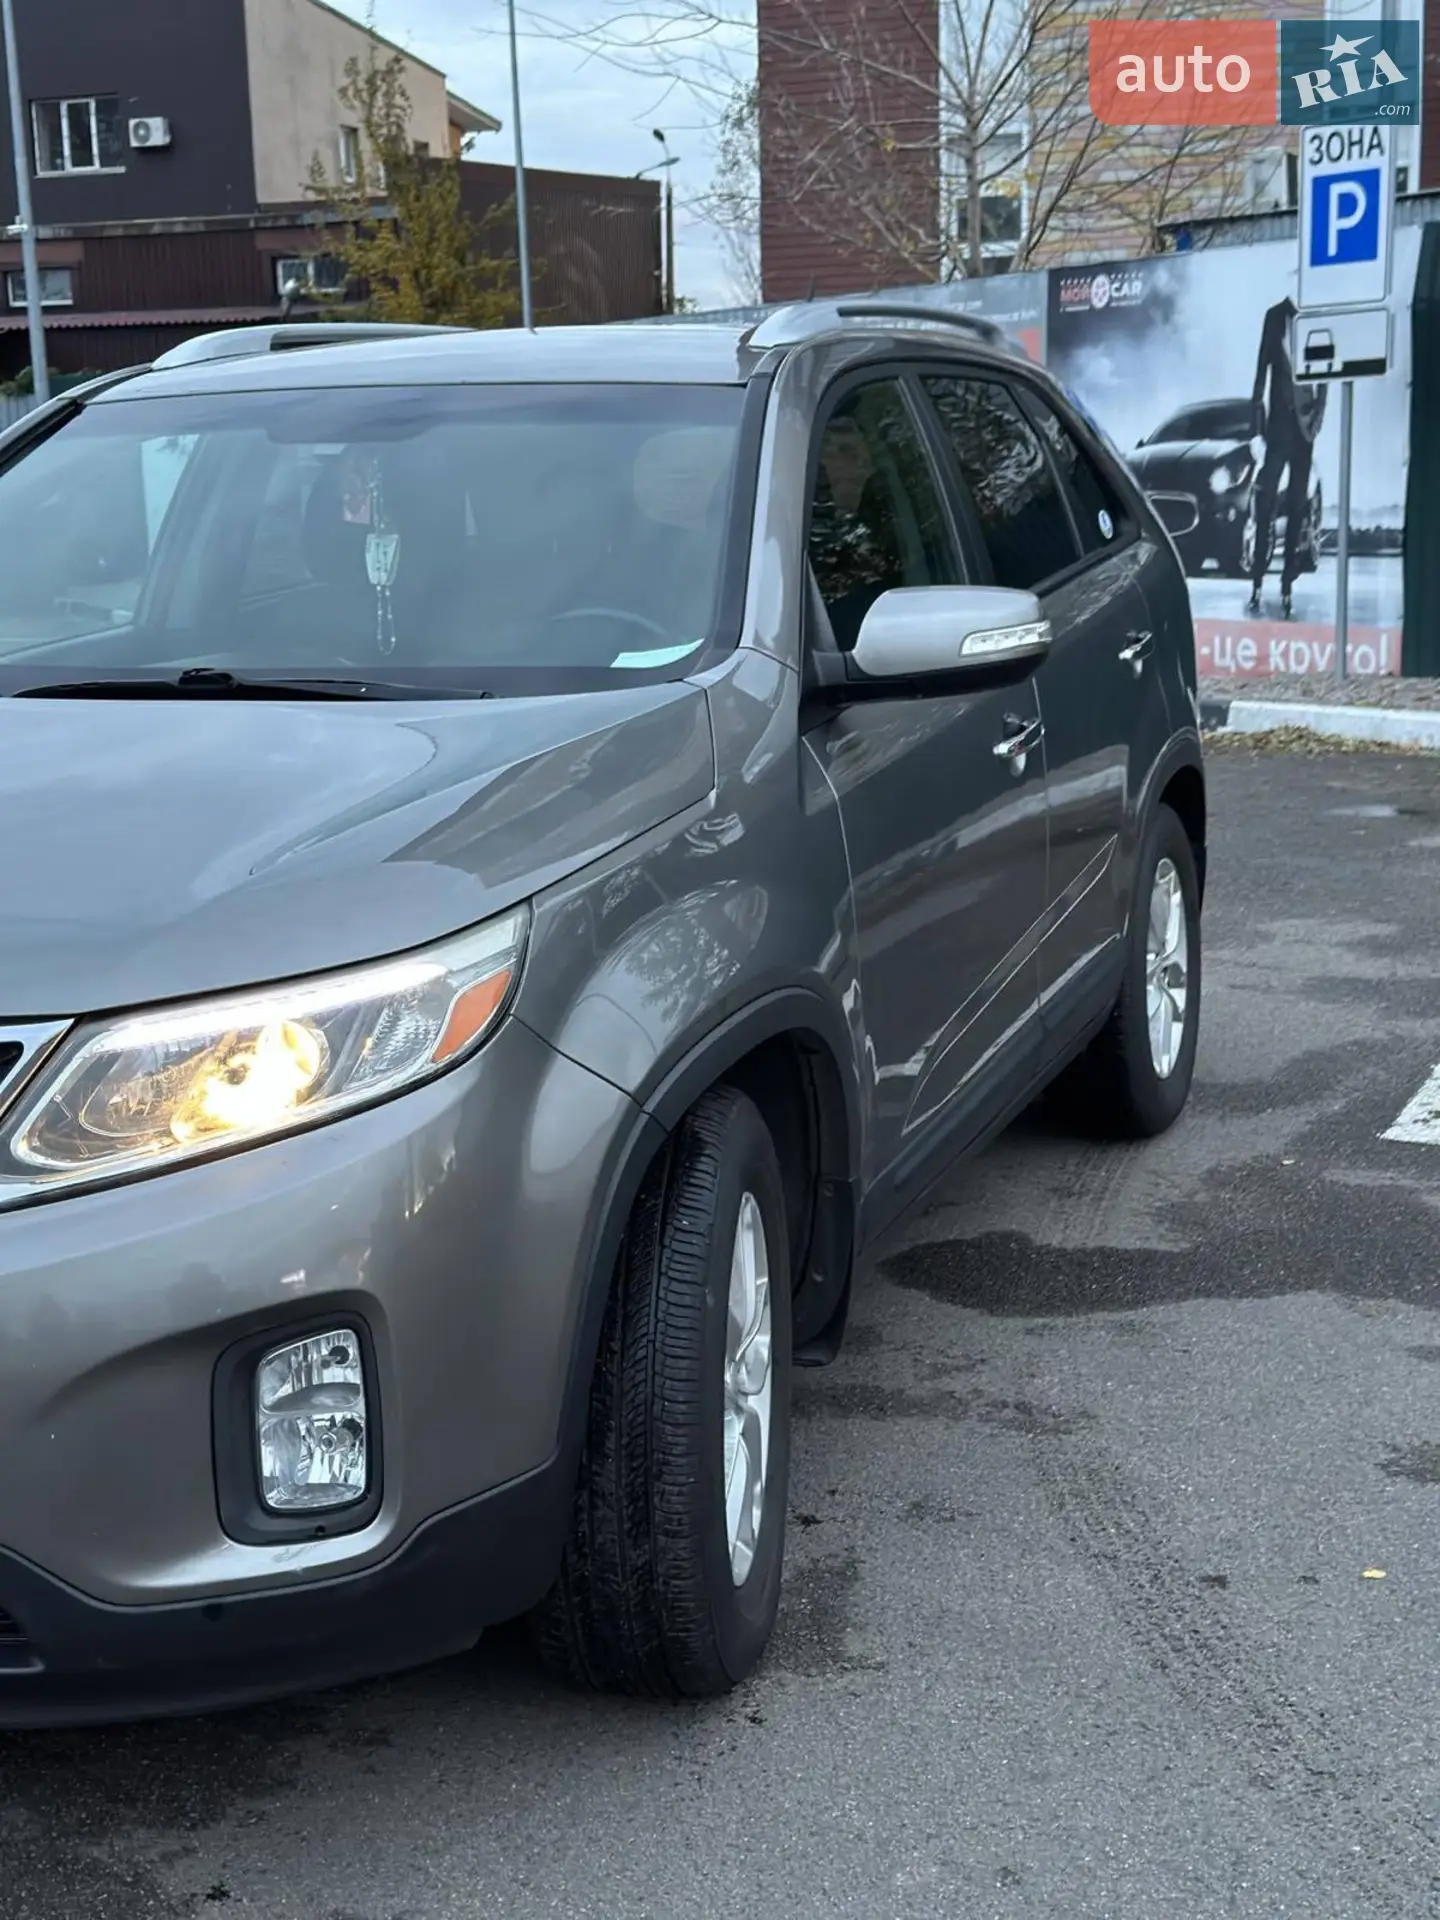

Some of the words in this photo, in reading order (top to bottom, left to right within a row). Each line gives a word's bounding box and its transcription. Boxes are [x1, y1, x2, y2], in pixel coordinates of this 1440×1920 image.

[1308, 126, 1385, 166] ЗОНА
[1327, 181, 1367, 257] P
[1111, 280, 1143, 297] CAR
[1268, 633, 1389, 675] круо!
